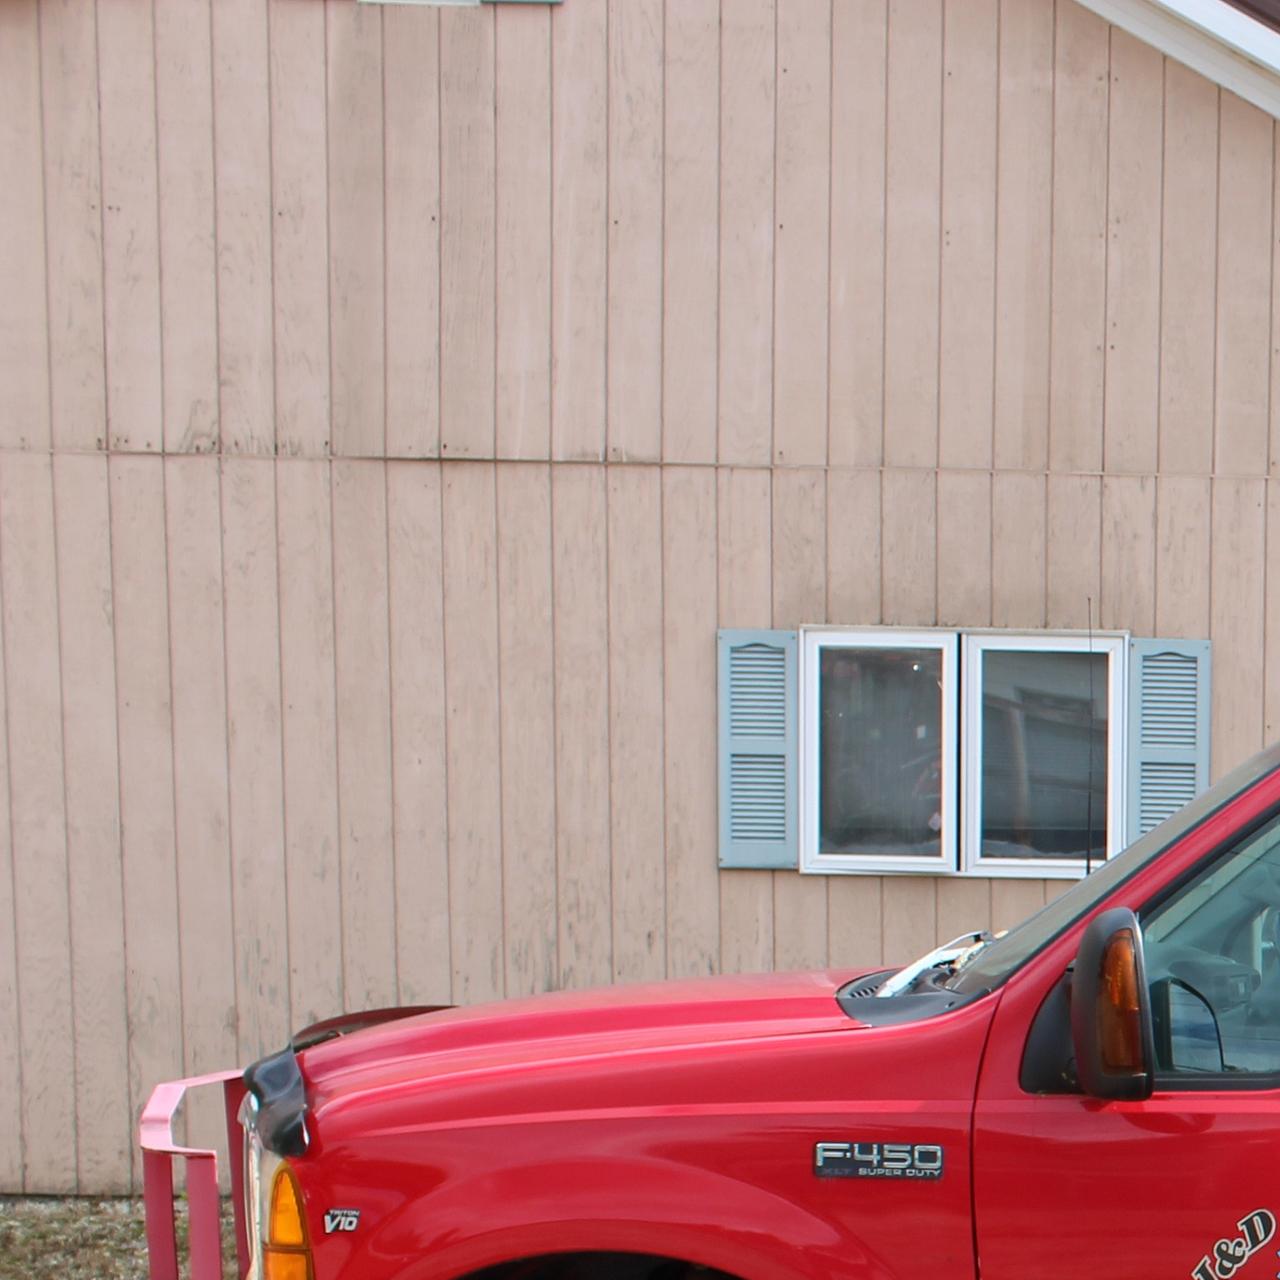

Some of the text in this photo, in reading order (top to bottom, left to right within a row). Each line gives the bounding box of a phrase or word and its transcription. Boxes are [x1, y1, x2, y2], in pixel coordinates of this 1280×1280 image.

[858, 1167, 902, 1177] SUPER
[905, 1168, 942, 1177] DUTY
[324, 1214, 358, 1234] V10
